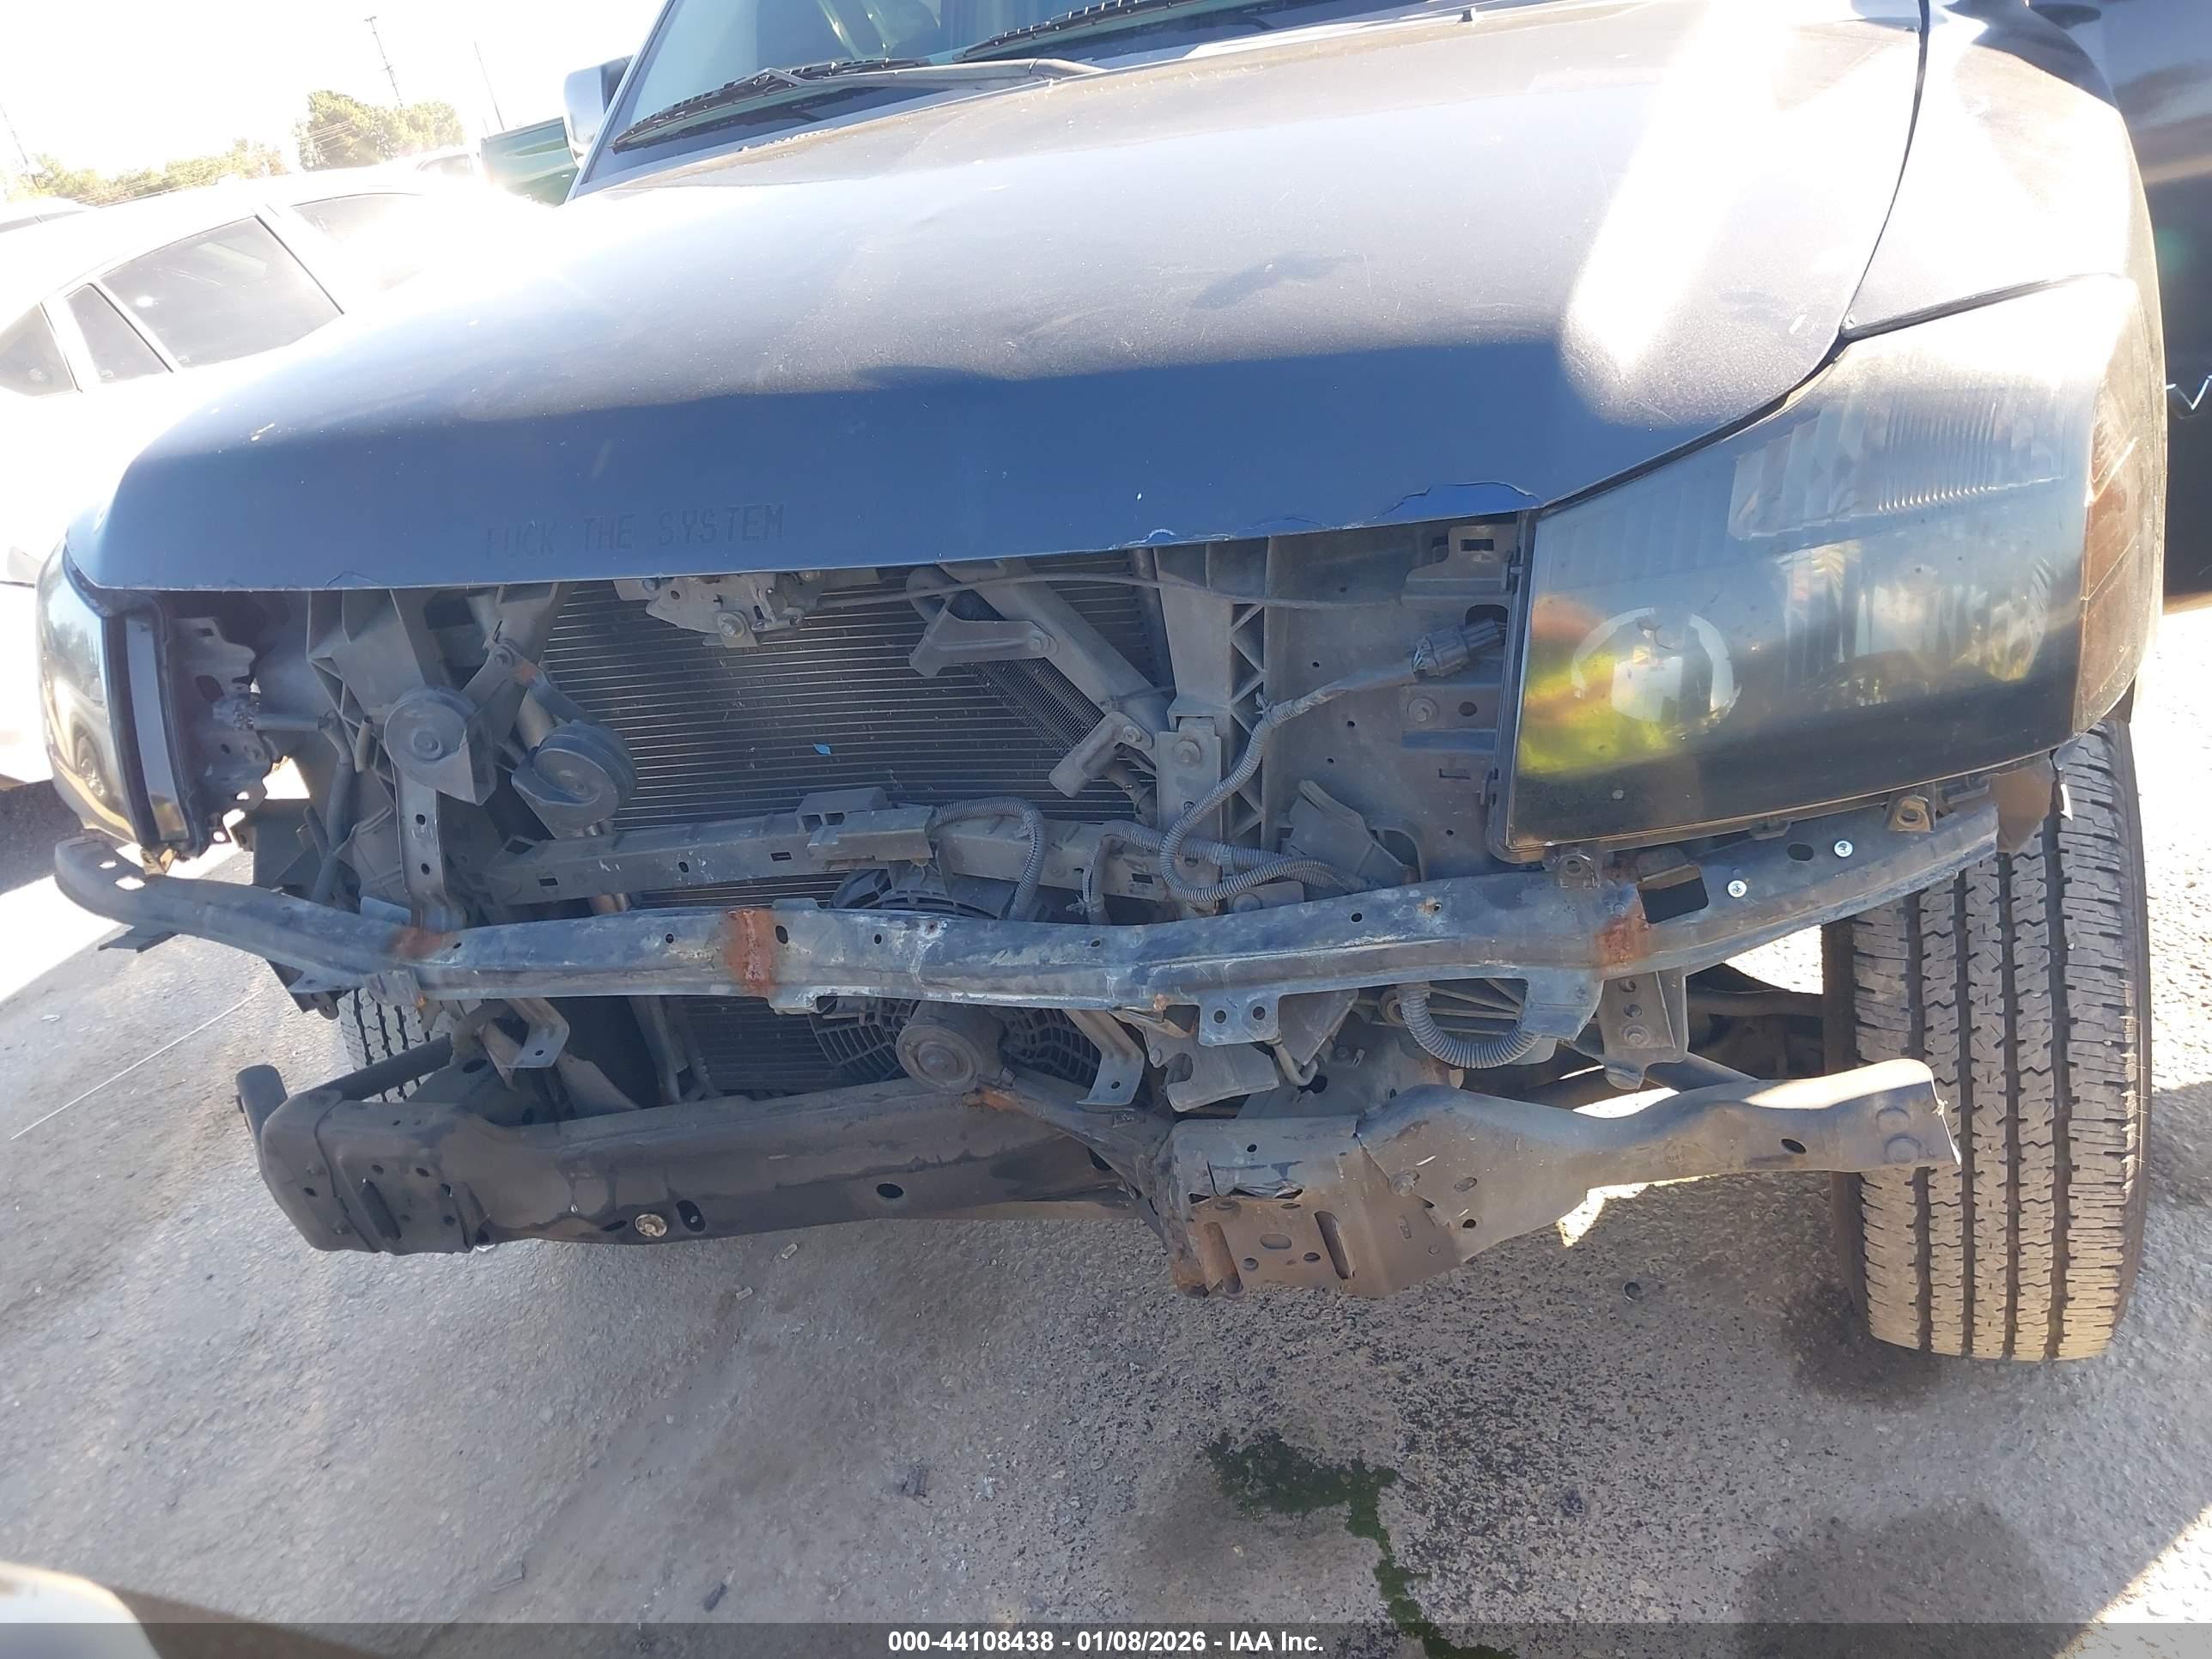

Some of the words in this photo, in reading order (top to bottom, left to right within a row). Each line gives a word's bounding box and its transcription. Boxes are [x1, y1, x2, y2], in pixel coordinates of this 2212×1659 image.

[485, 520, 555, 560] FUCK
[583, 513, 636, 551] THE
[659, 502, 785, 545] SYSTEM
